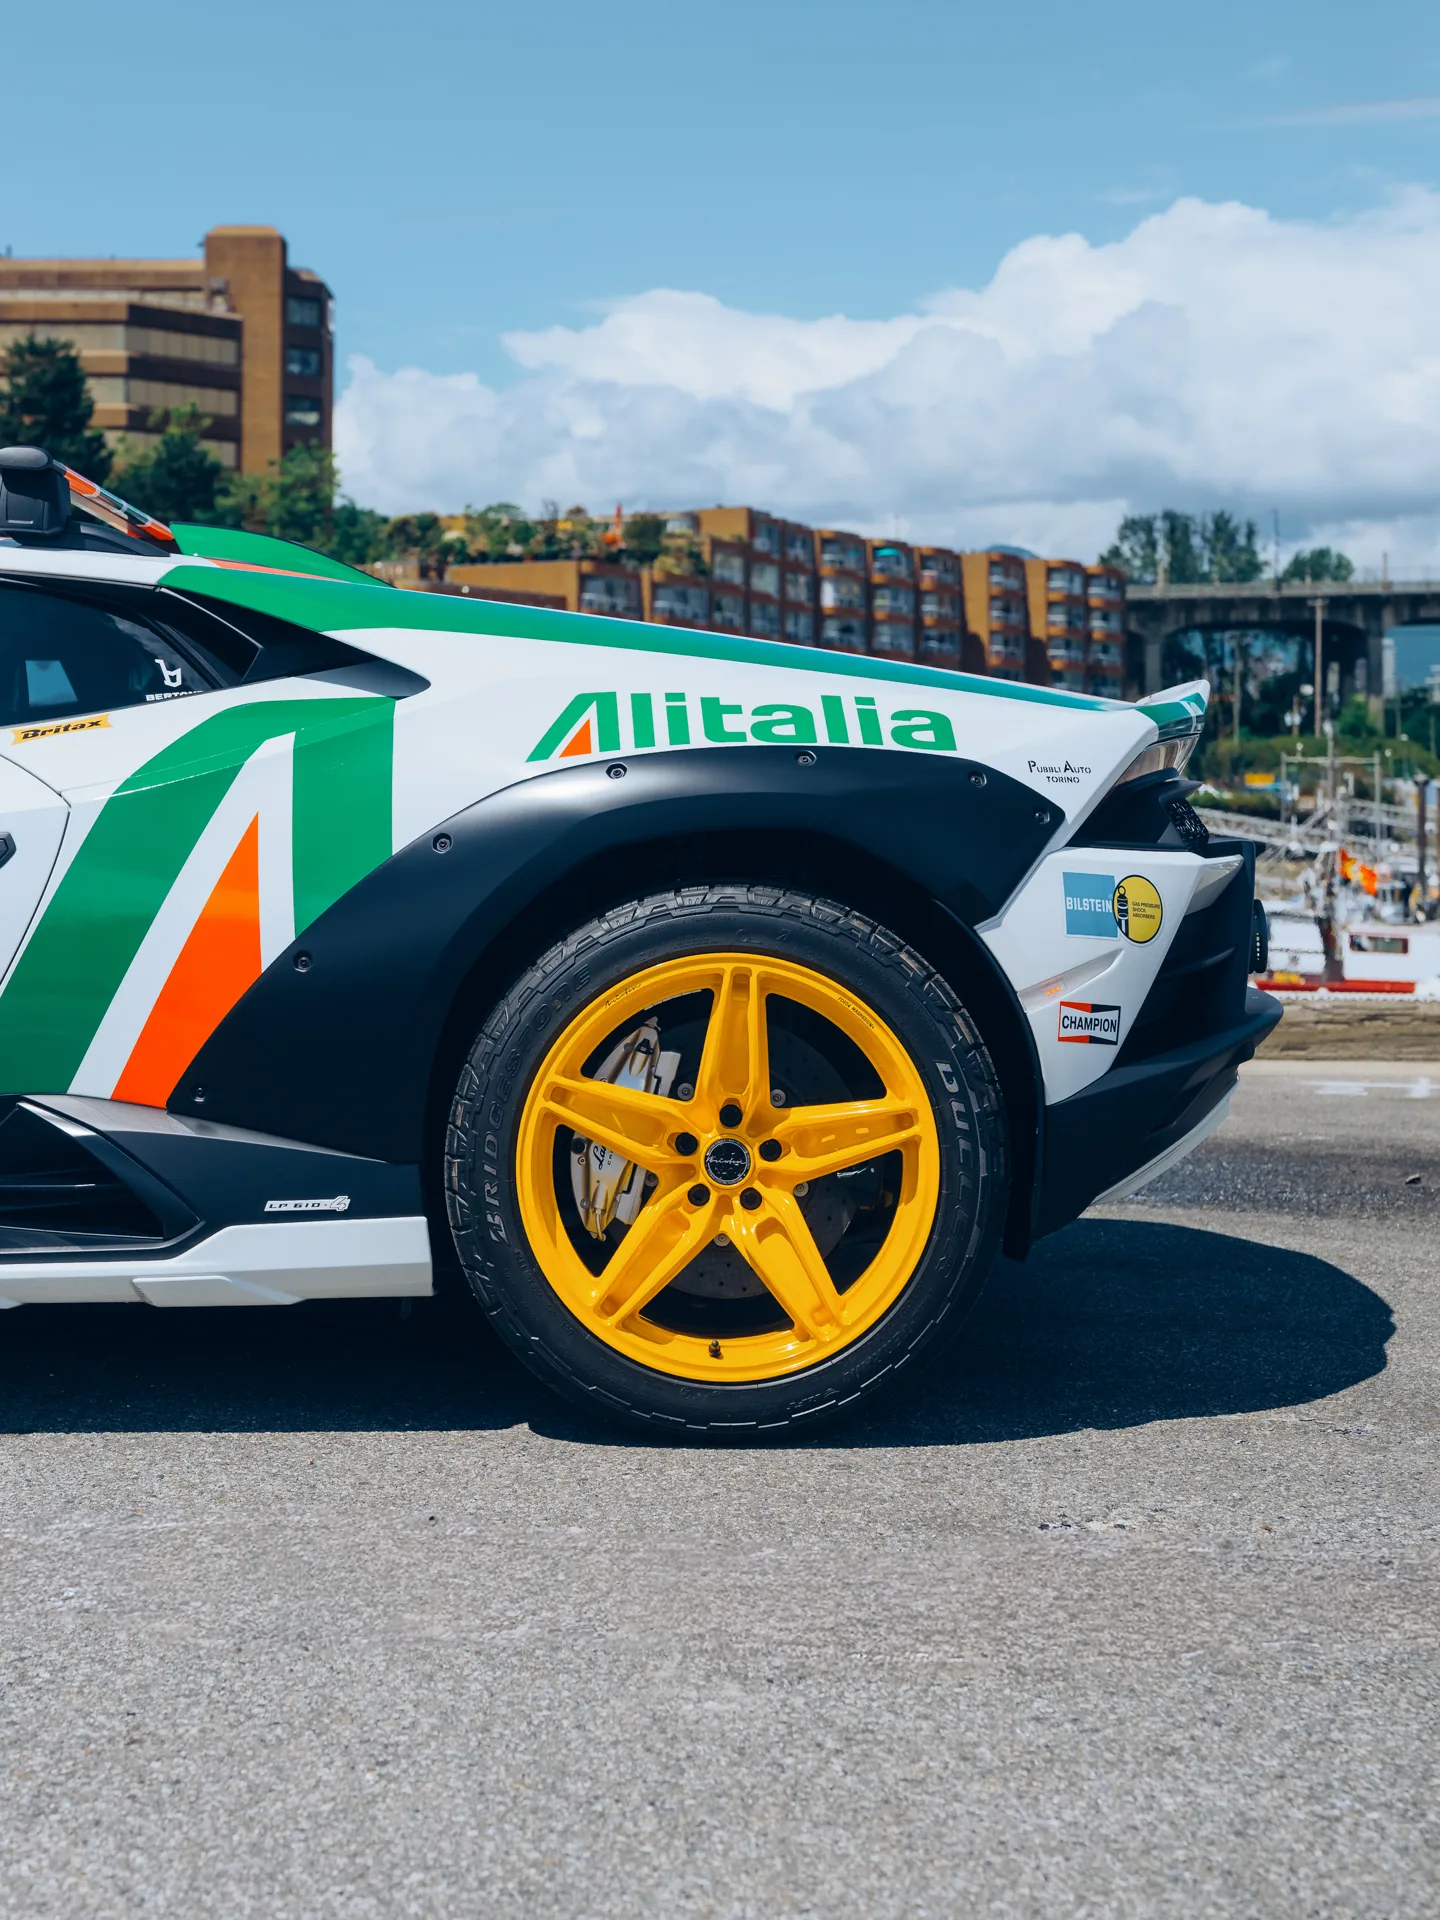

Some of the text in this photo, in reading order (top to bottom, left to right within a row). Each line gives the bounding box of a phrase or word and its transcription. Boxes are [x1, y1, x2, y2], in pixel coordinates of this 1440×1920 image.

[20, 719, 103, 740] Britax
[524, 691, 958, 763] Alitalia
[1046, 776, 1080, 784] TORINO
[1065, 896, 1113, 913] BILSTEIN
[1061, 1015, 1117, 1033] CHAMPION
[483, 963, 592, 1246] BRIDGESTONE
